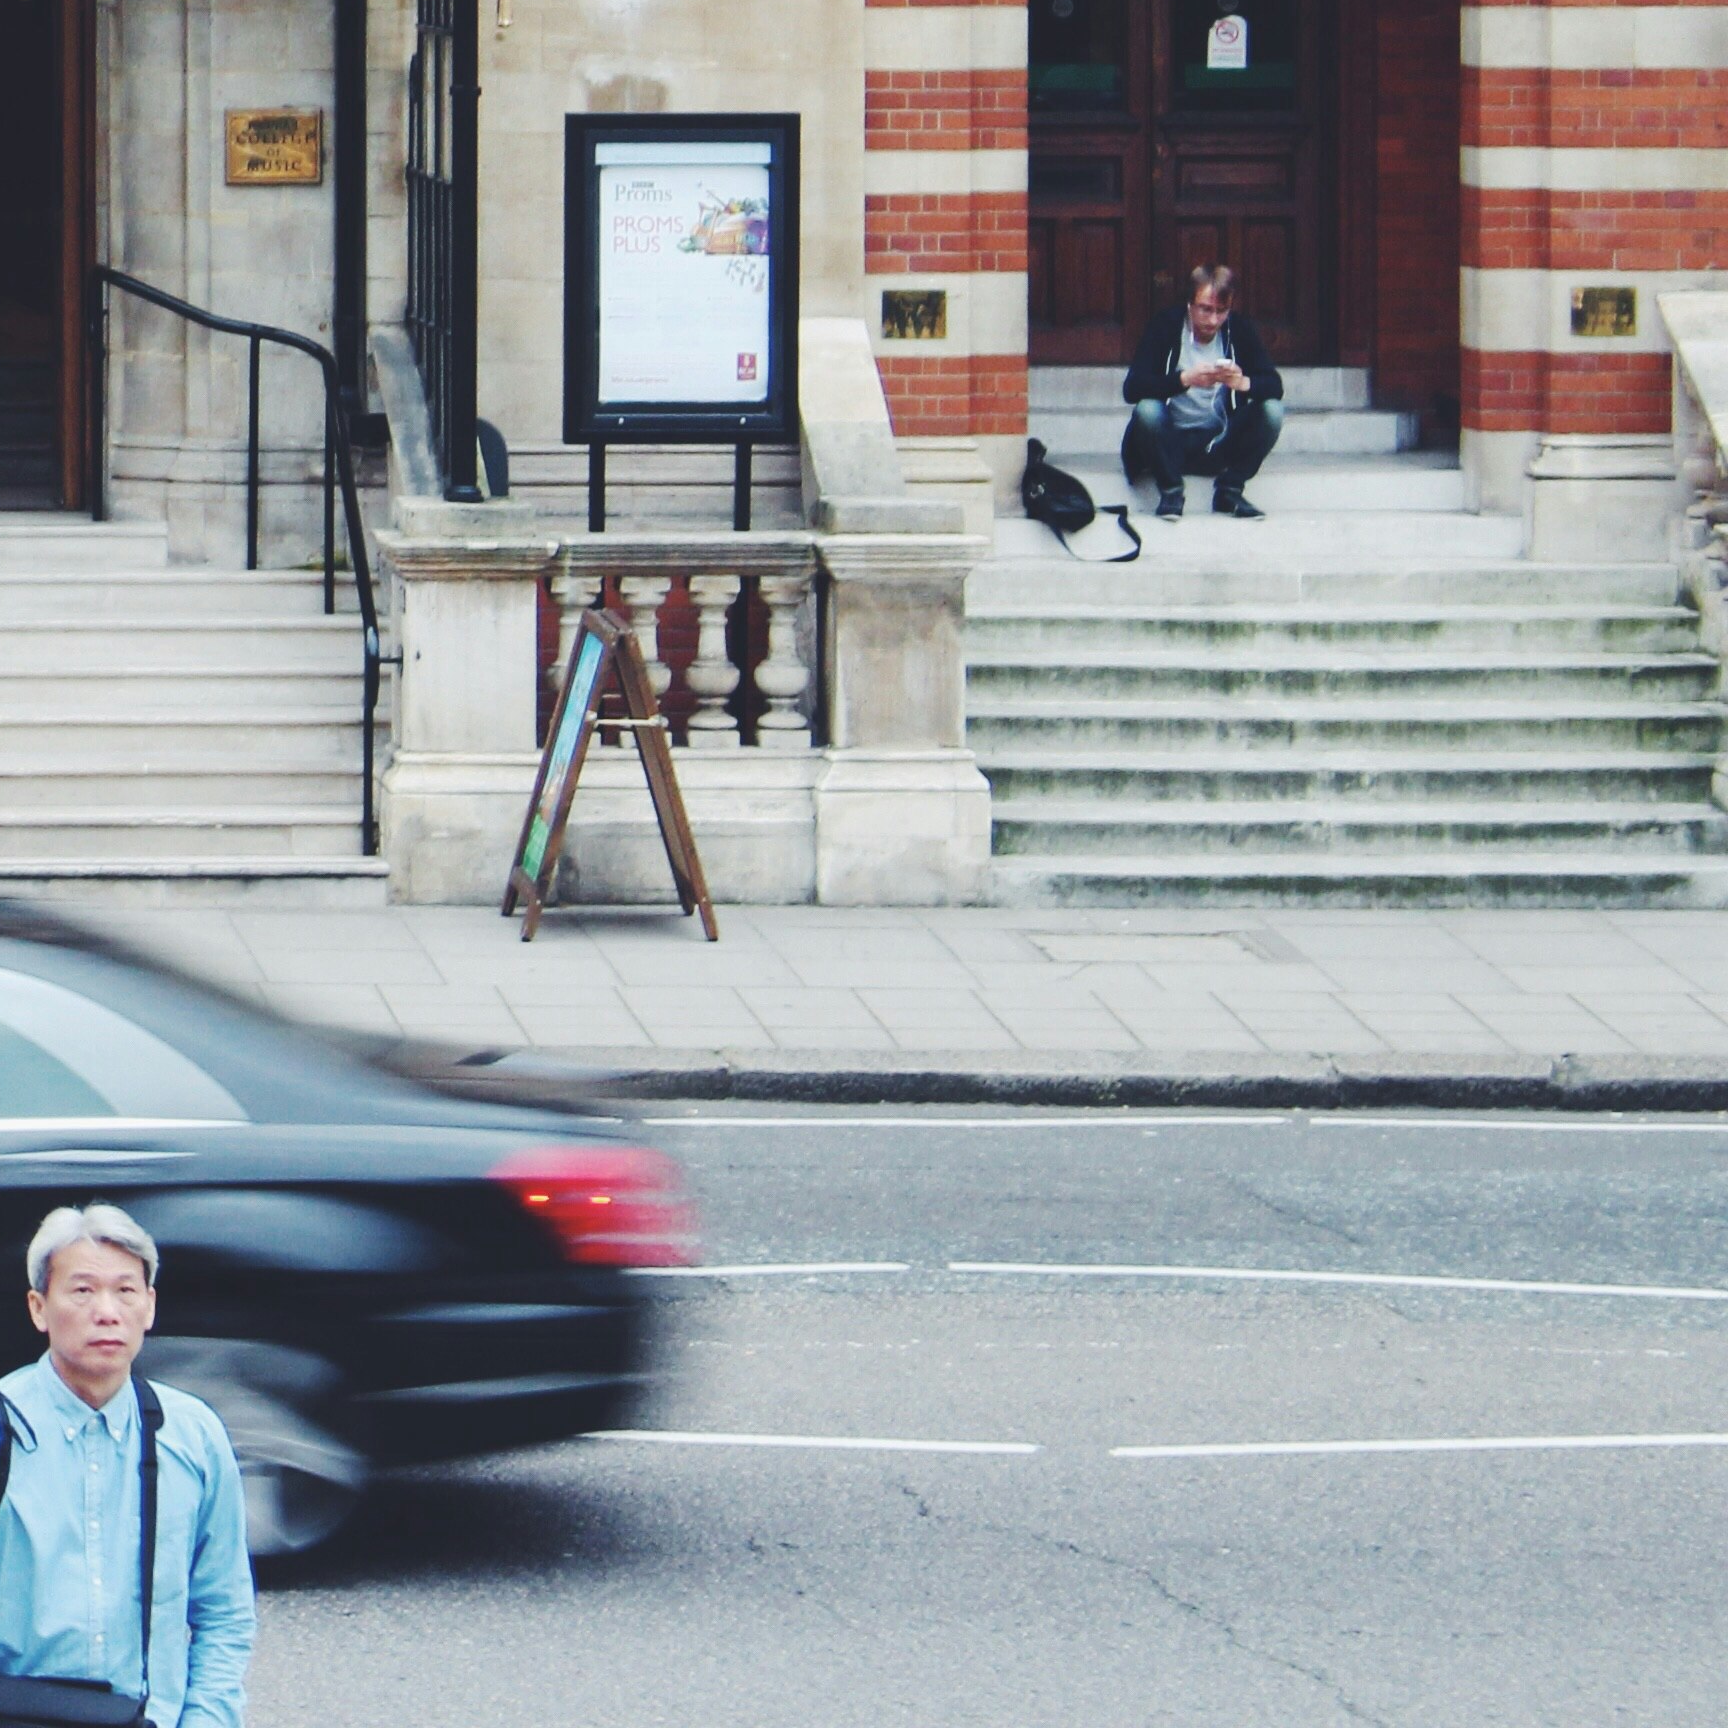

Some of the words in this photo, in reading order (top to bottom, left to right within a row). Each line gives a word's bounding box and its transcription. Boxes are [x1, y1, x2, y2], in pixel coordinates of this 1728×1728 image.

[615, 183, 673, 203] Proms
[613, 215, 684, 234] PROMS
[613, 235, 661, 254] PLUS
